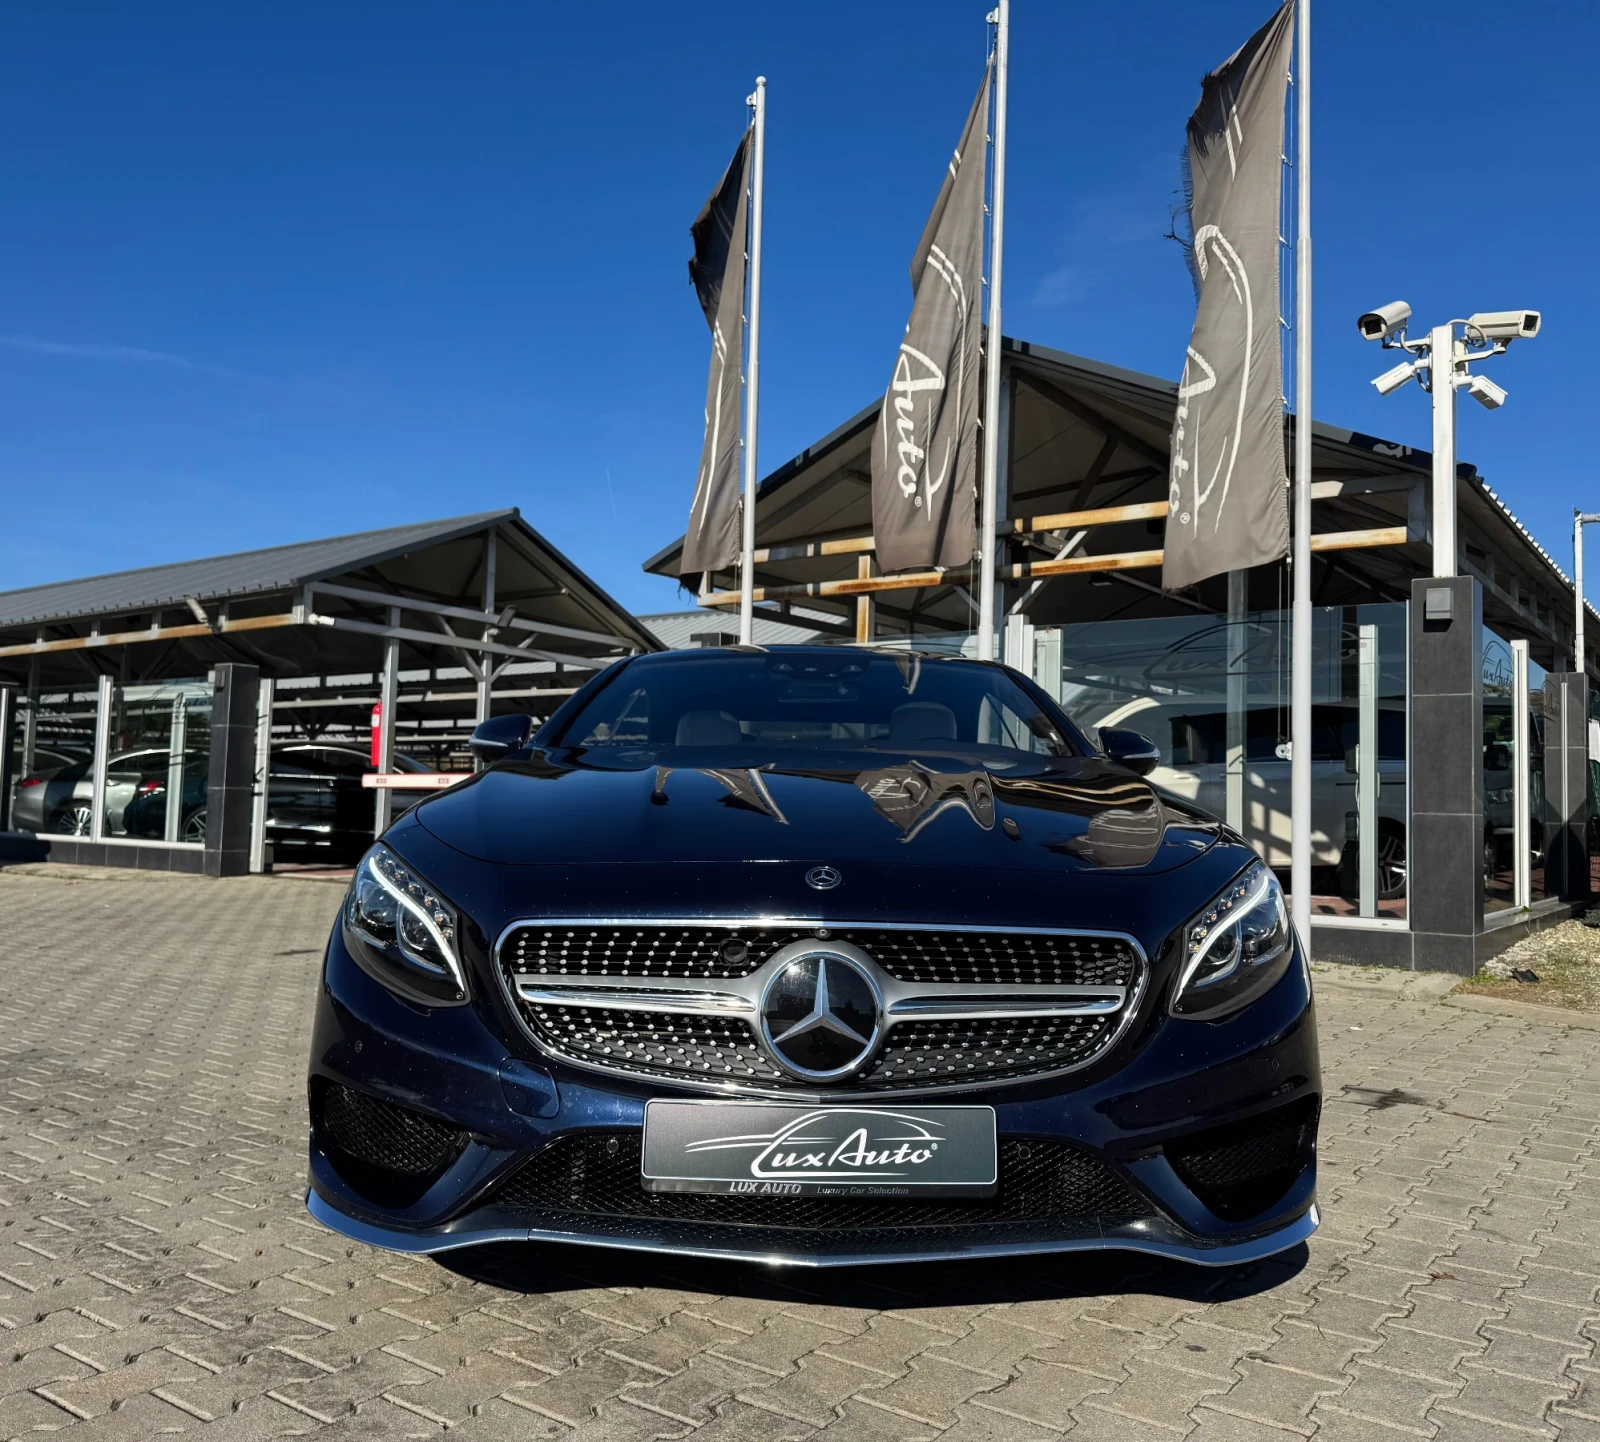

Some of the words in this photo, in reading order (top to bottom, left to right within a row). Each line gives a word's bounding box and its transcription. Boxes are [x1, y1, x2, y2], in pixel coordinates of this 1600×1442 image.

[729, 1181, 758, 1193] LUX
[760, 1182, 802, 1194] AUTO
[817, 1186, 848, 1196] Luxury
[850, 1186, 866, 1195] Car
[867, 1186, 909, 1195] Selection
